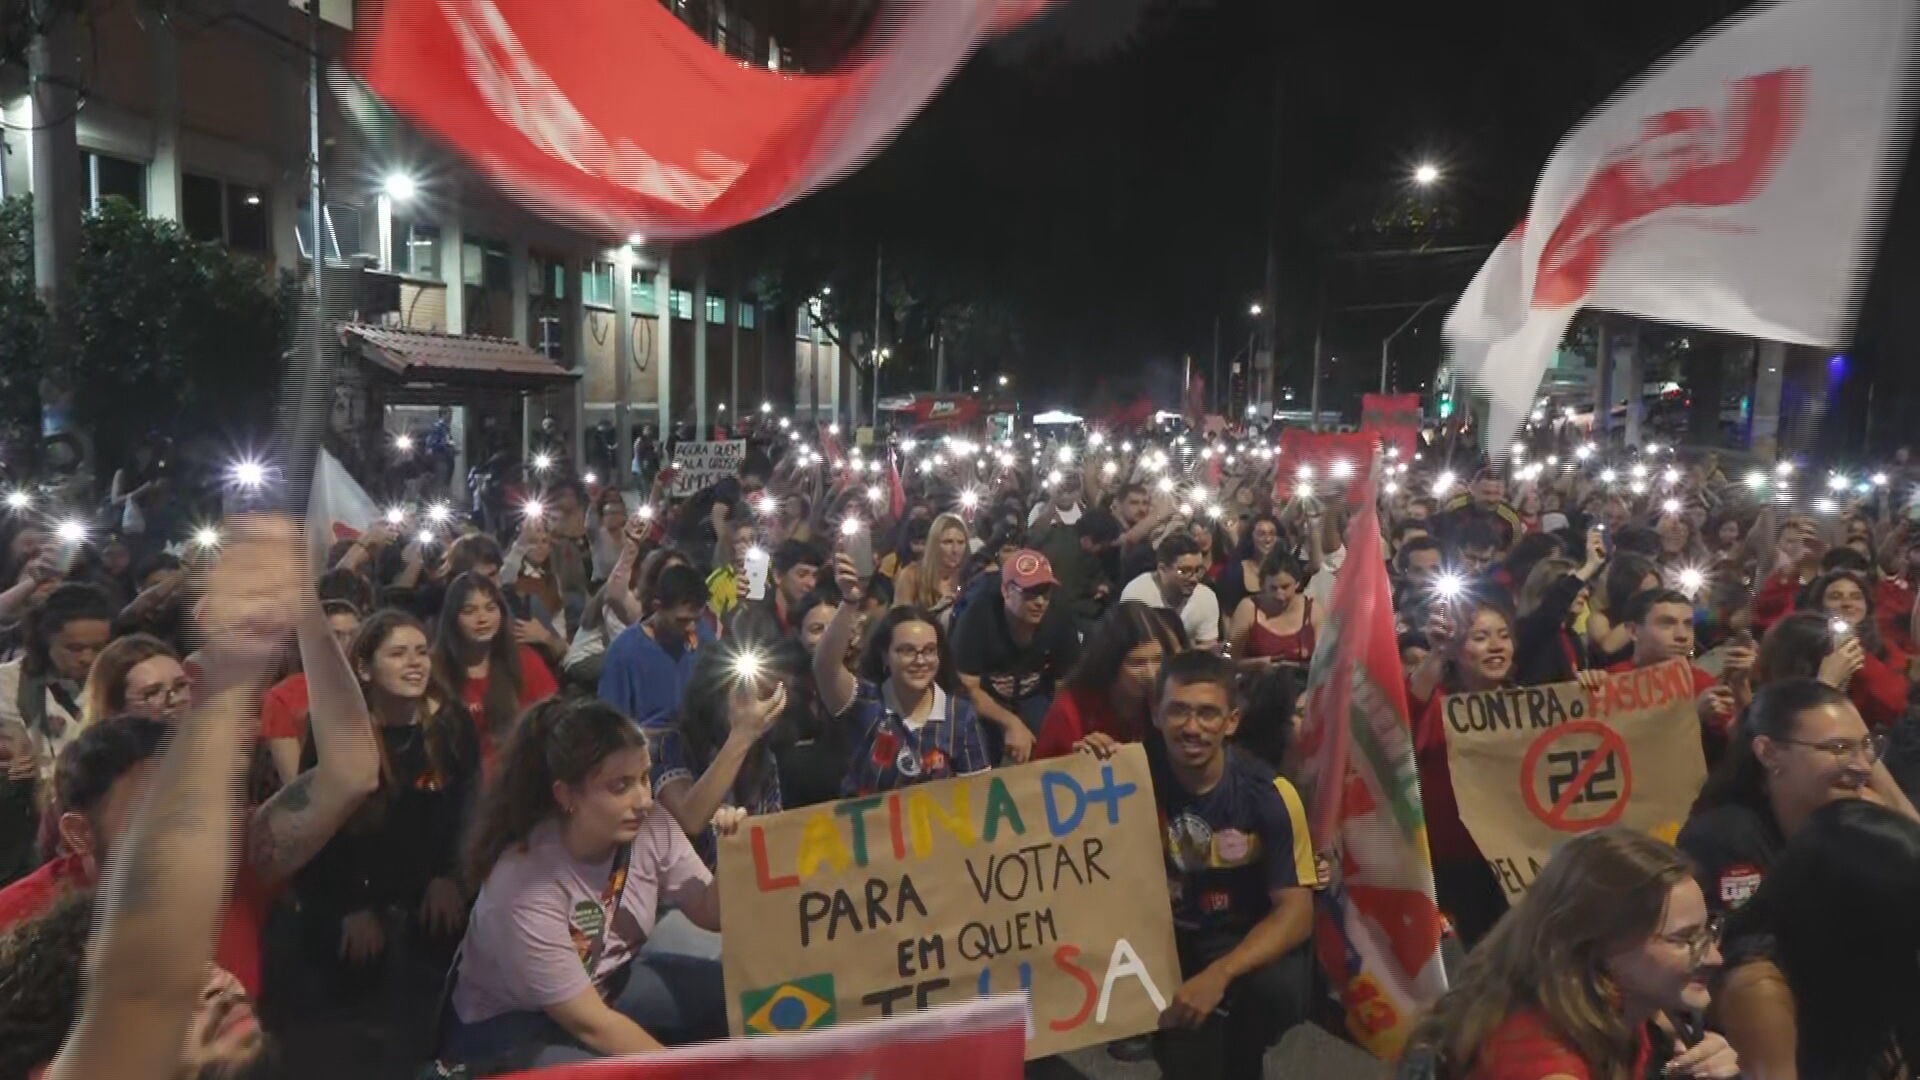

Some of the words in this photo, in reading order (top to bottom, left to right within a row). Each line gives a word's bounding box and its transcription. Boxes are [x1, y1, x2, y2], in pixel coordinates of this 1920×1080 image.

[1447, 687, 1567, 733] CONTRA
[1547, 749, 1618, 804] 22
[751, 776, 1026, 893] LATINA
[1041, 765, 1137, 838] D+
[799, 873, 928, 947] PARA
[965, 838, 1111, 904] VOTAR
[897, 933, 945, 977] EM
[957, 906, 1058, 962] QUEM
